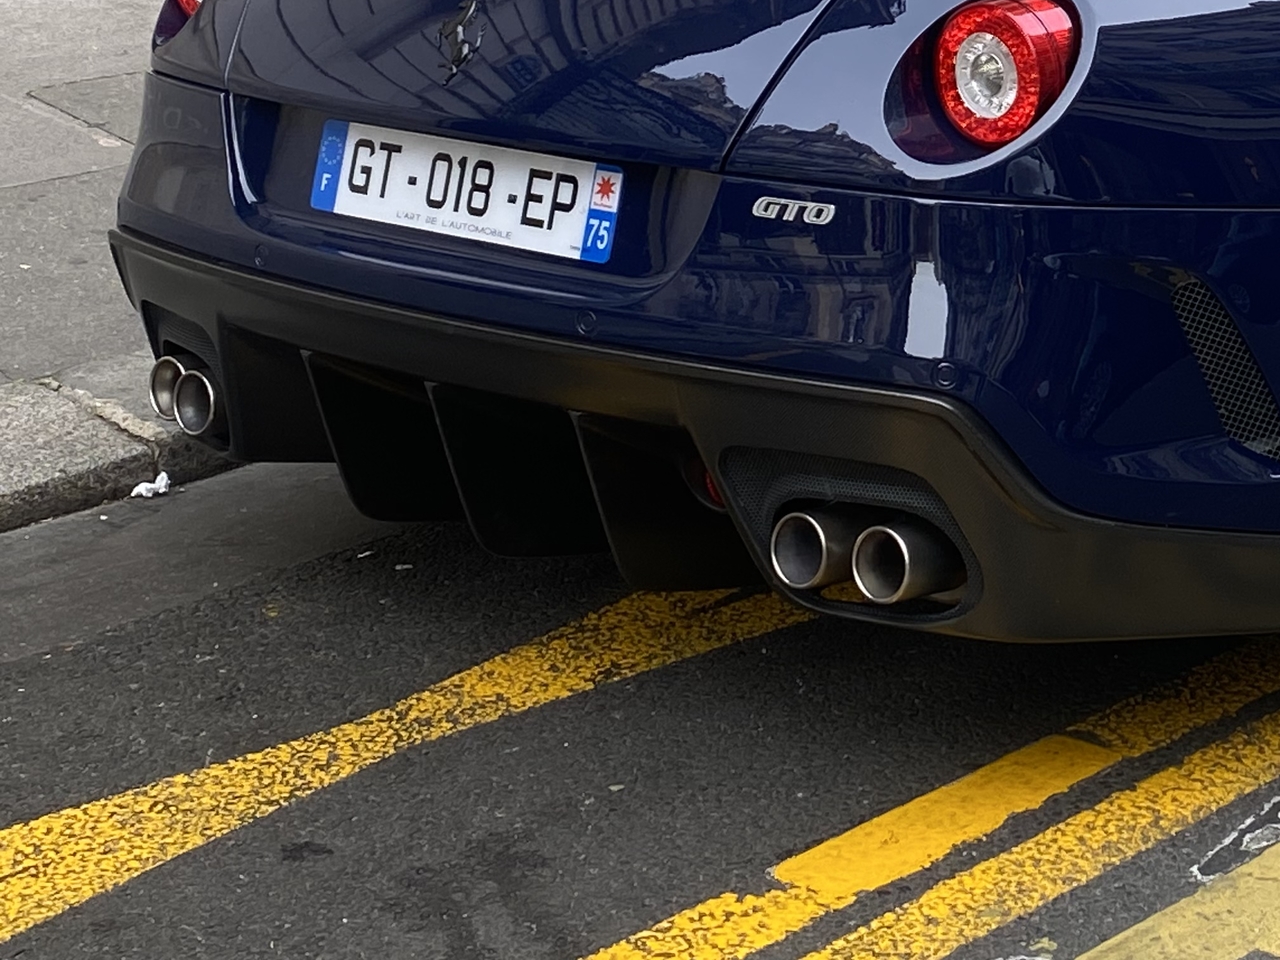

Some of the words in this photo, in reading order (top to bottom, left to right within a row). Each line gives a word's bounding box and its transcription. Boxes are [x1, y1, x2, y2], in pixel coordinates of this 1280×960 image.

[320, 173, 332, 191] F
[752, 196, 836, 225] GTO
[586, 218, 611, 250] 75
